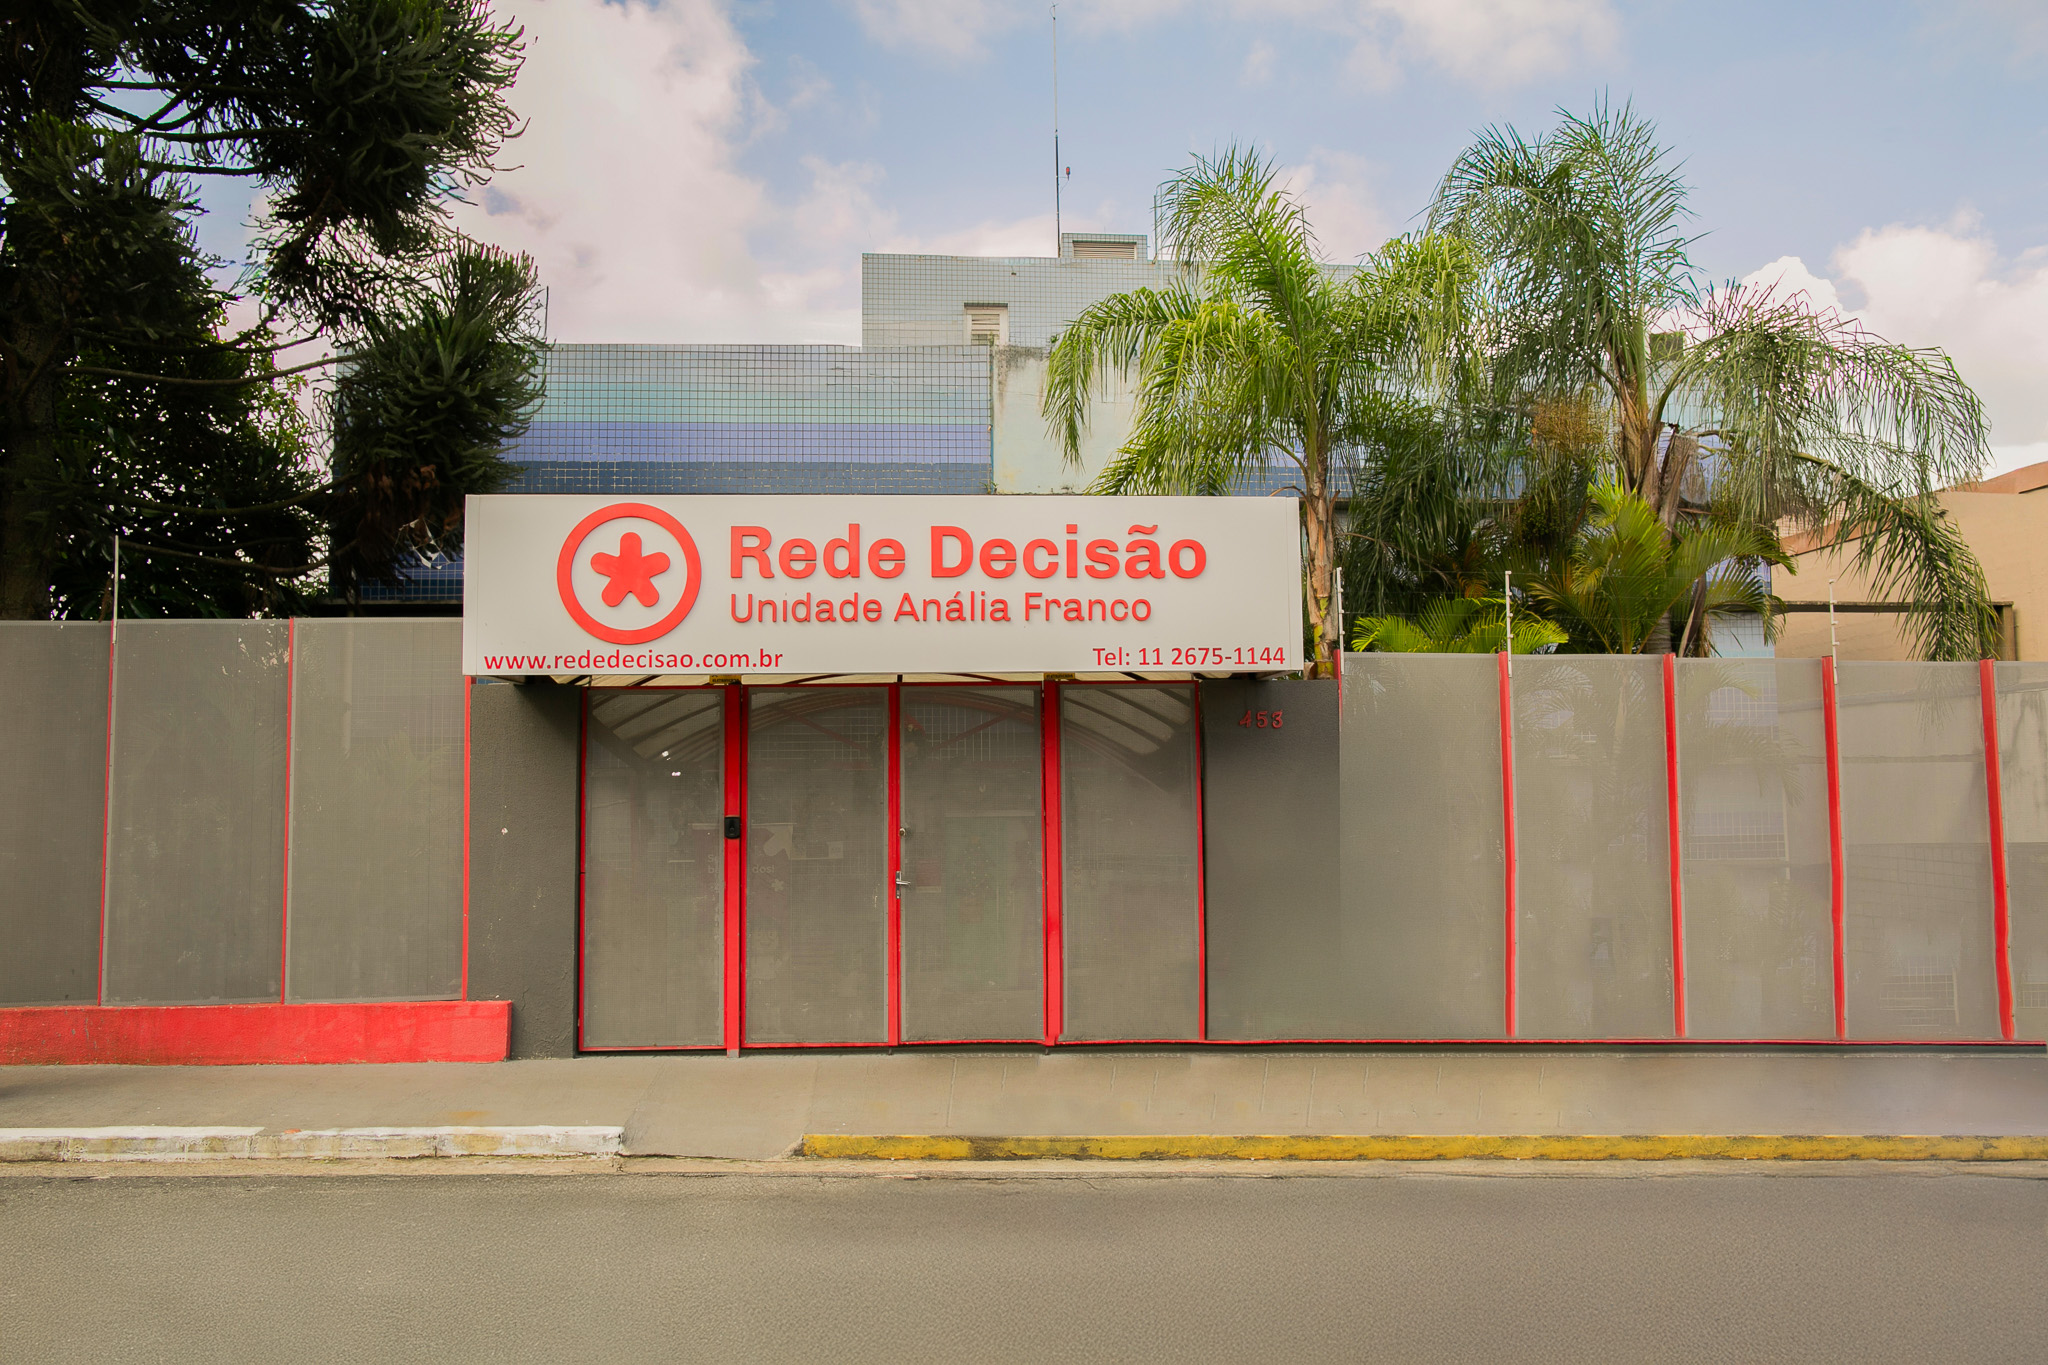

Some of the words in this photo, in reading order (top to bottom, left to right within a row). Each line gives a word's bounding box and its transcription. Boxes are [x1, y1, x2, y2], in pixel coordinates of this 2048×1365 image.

[730, 523, 906, 580] Rede
[930, 523, 1207, 580] Decisão
[730, 592, 883, 623] Unidade
[893, 590, 1012, 622] Anália
[1024, 592, 1152, 622] Franco
[483, 648, 783, 670] www.rededecisao.com.br
[1092, 647, 1131, 666] Tel:
[1138, 647, 1164, 666] 11
[1171, 646, 1286, 666] 2675-1144
[1239, 709, 1284, 728] 453
